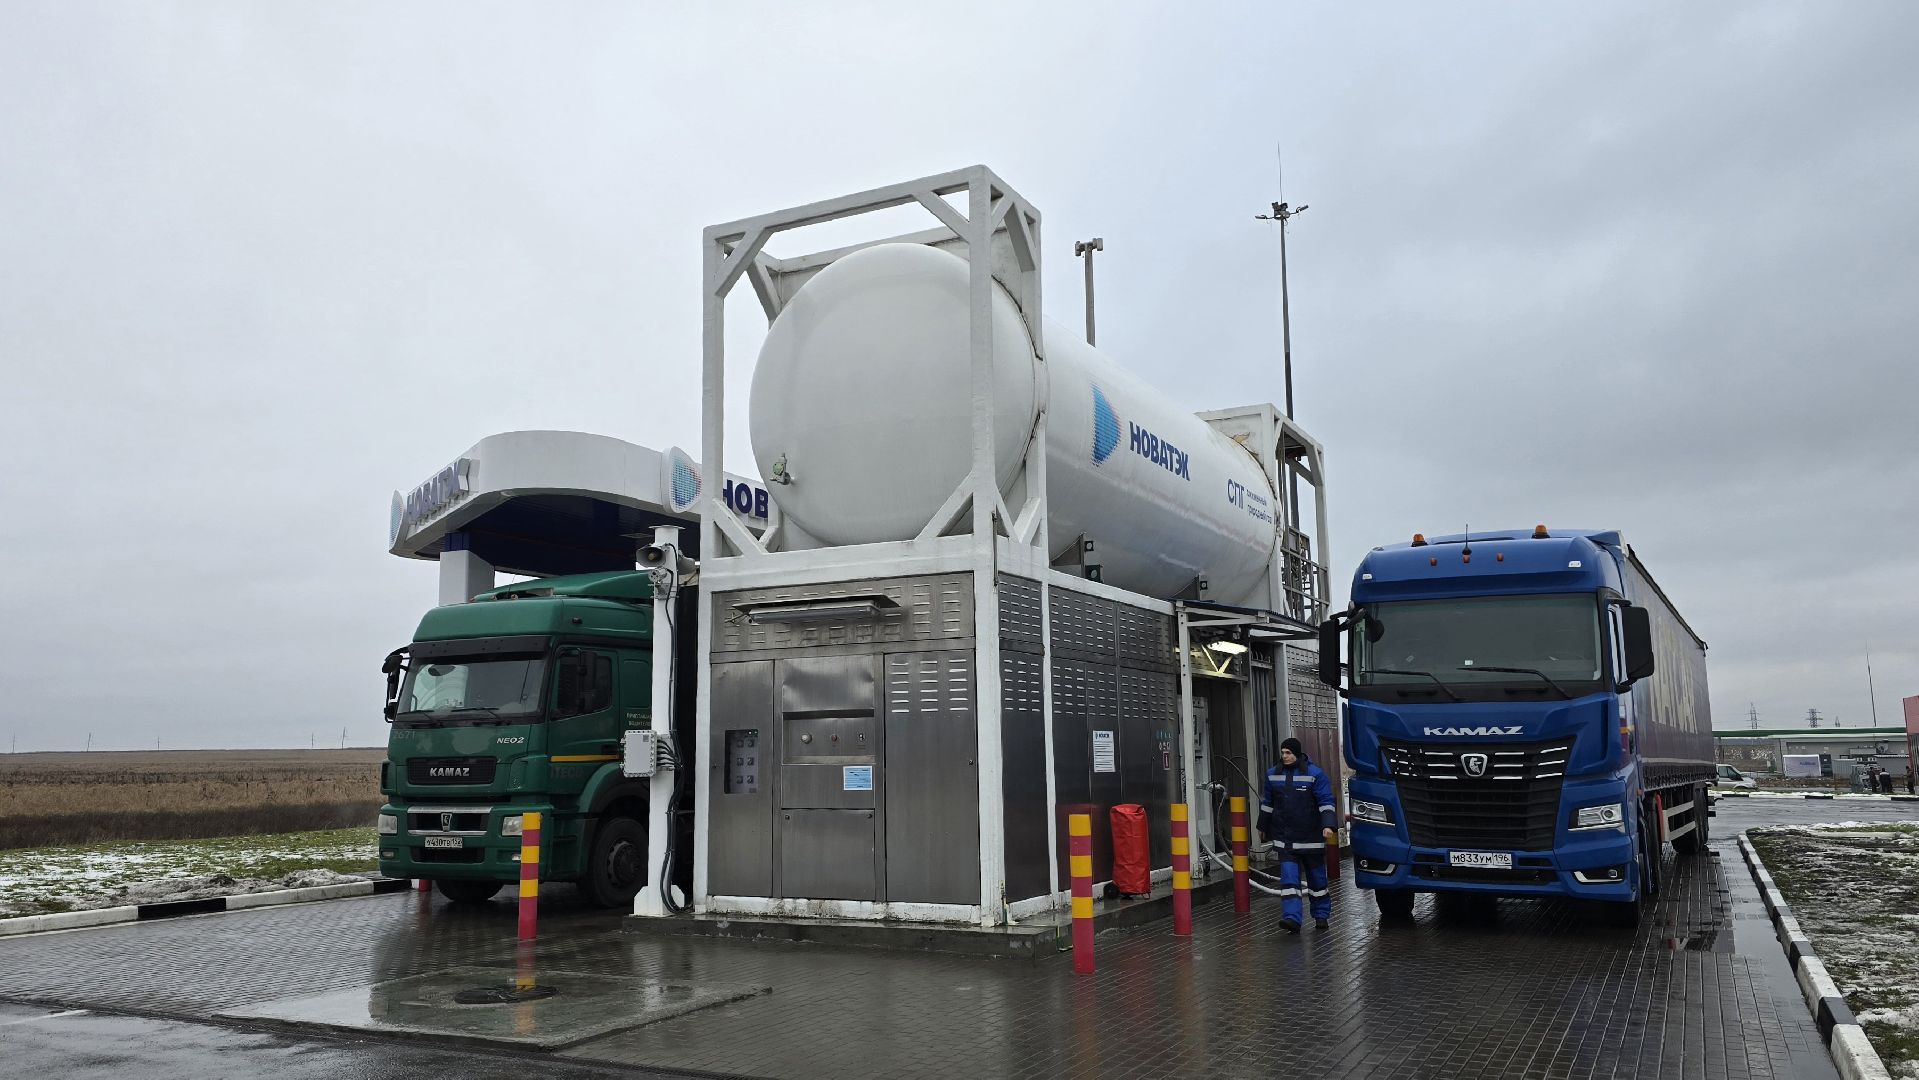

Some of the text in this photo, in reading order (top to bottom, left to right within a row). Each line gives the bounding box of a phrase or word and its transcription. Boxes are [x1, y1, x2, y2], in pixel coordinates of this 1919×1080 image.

[1129, 420, 1190, 481] НОВАТЭК
[1227, 478, 1245, 509] СПГ
[1423, 726, 1523, 736] KAMAZ
[496, 736, 524, 744] NEO2
[429, 767, 470, 777] KAMAZ
[1453, 853, 1509, 863] М833УМ 196
